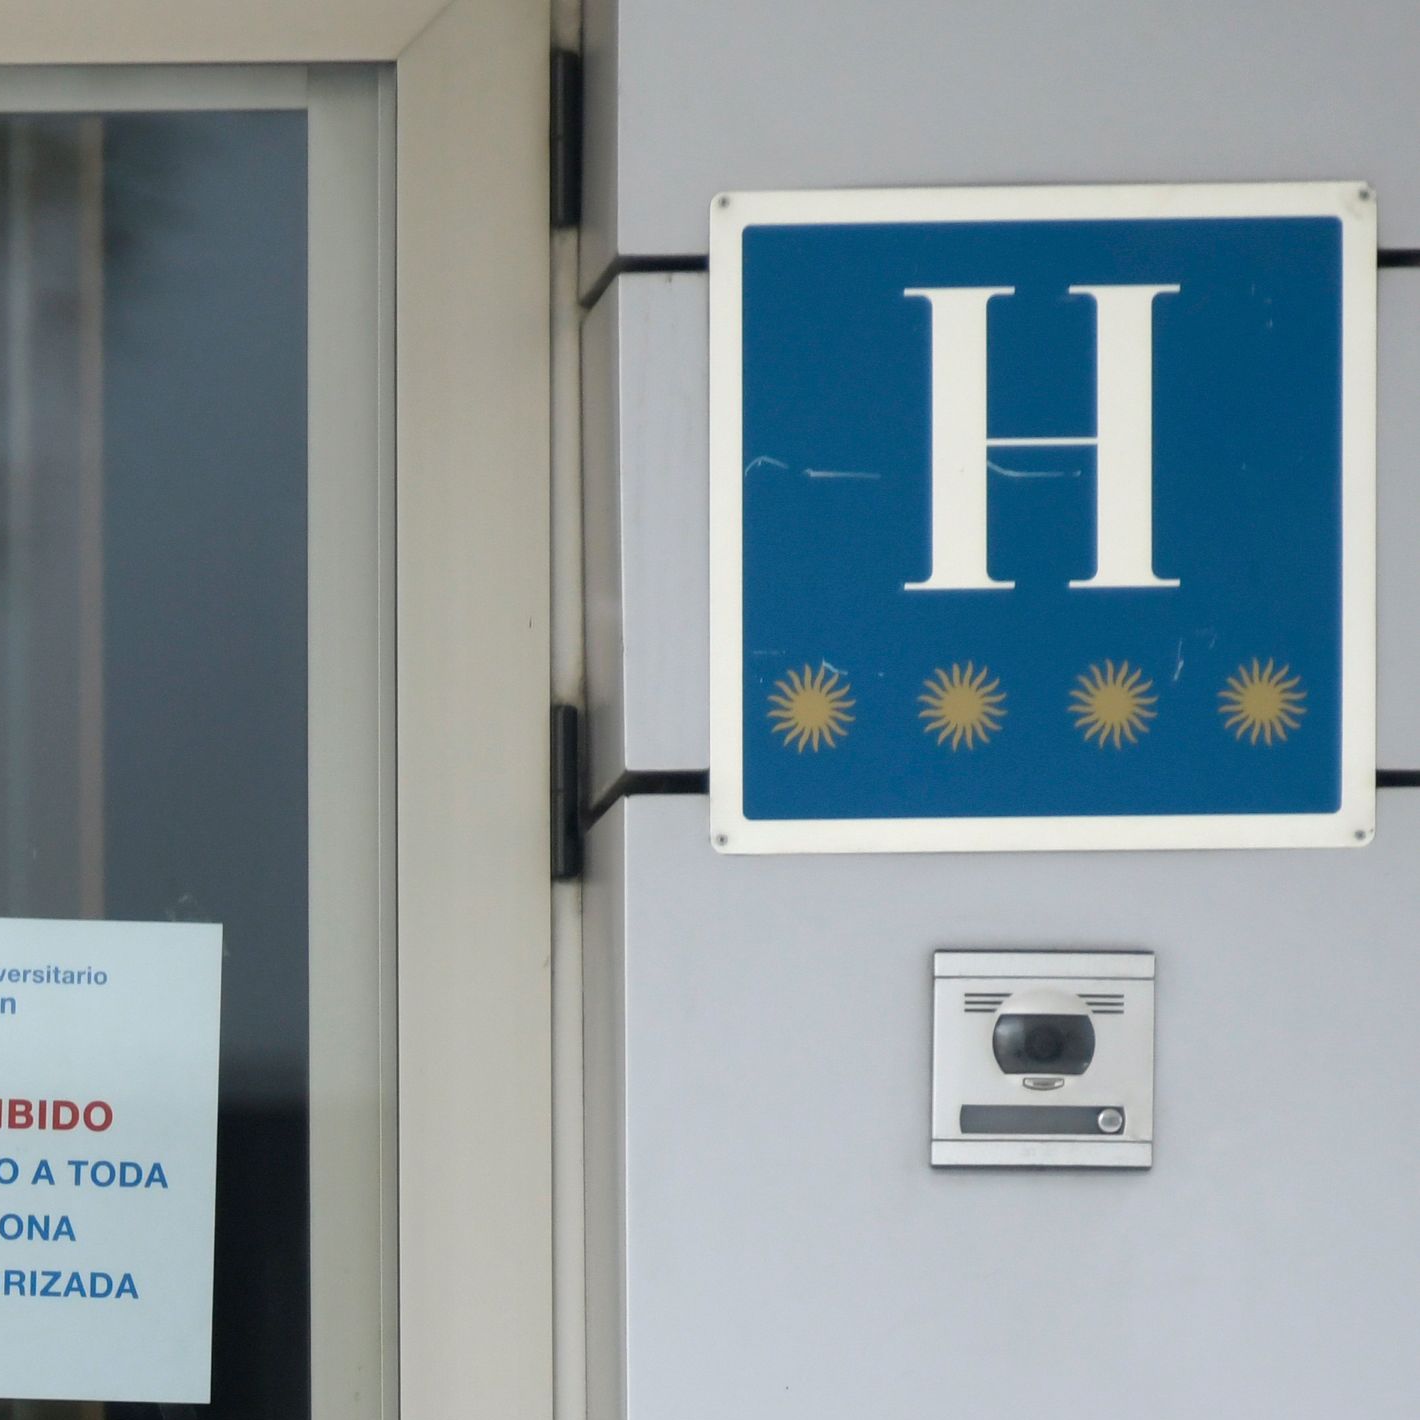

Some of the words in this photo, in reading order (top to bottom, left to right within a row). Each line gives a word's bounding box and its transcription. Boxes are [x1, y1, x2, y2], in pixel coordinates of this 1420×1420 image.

[903, 283, 1181, 591] H
[31, 1159, 55, 1186] A
[67, 1160, 169, 1189] TODA
